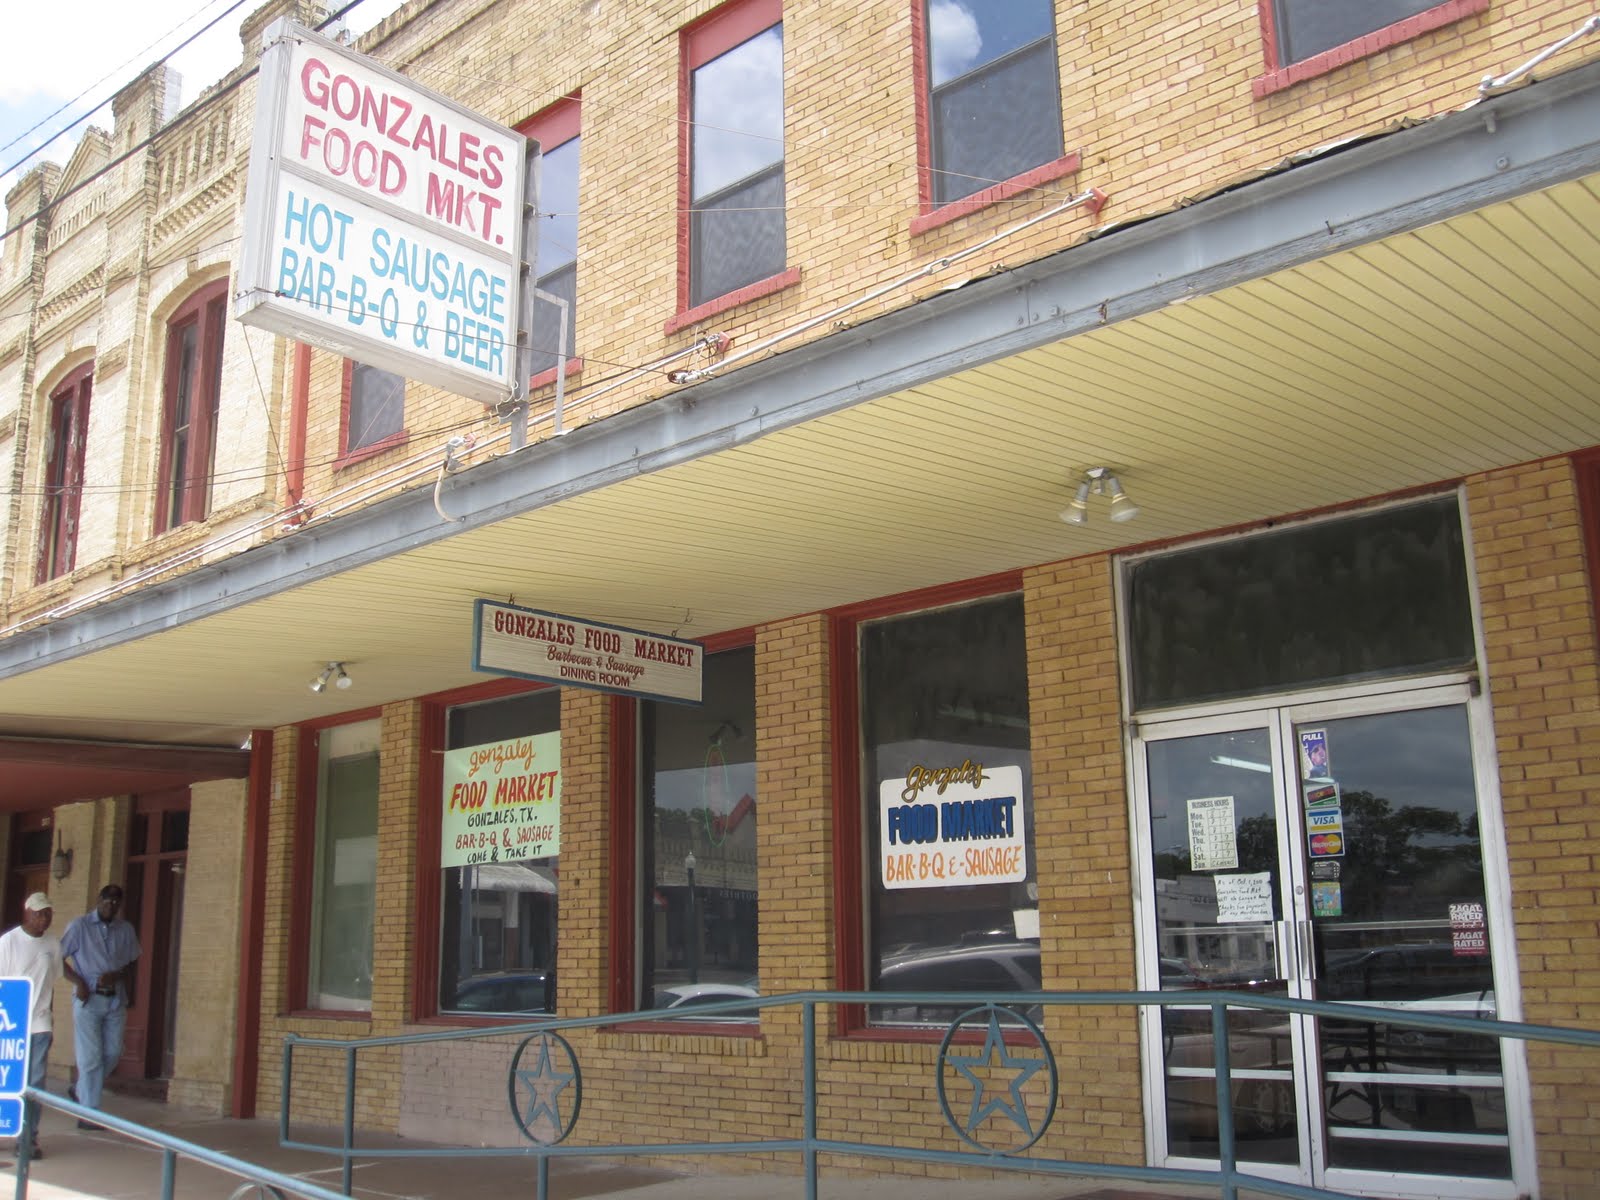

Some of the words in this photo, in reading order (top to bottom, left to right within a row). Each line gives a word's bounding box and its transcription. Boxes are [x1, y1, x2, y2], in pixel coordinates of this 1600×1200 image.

[301, 58, 504, 189] GONZALES
[299, 115, 407, 196] FOOD
[425, 172, 504, 245] MKT.
[284, 190, 353, 261] HOT
[370, 228, 505, 323] SAUSAGE
[279, 247, 399, 340] BAR-B-Q
[413, 300, 429, 350] &
[444, 311, 504, 375] BEER
[494, 610, 575, 646] GONZALES
[584, 628, 621, 654] FOOD
[634, 638, 694, 667] MARKET
[546, 645, 593, 667] Barbecue
[605, 656, 645, 680] Sausage
[560, 665, 596, 682] DINING
[599, 672, 630, 687] ROOM
[1303, 733, 1322, 741] PULL
[450, 780, 488, 811] FOOD
[495, 770, 558, 805] MARKET
[520, 807, 538, 822] TX.
[1191, 800, 1213, 809] BUSINESS
[1214, 799, 1230, 807] HOURS
[888, 804, 938, 845] FOOD
[941, 796, 1017, 842] MARKET
[1313, 816, 1335, 825] VISA
[502, 827, 513, 847] &
[517, 825, 554, 844] SAUSAGE
[1311, 841, 1342, 849] MasterCard
[467, 850, 487, 864] COME
[491, 846, 499, 862] &
[505, 846, 528, 859] TAKE
[533, 845, 542, 855] IT
[1449, 903, 1483, 912] ZAGAT
[1452, 931, 1484, 940] ZAGAT
[1453, 939, 1485, 947] RATED
